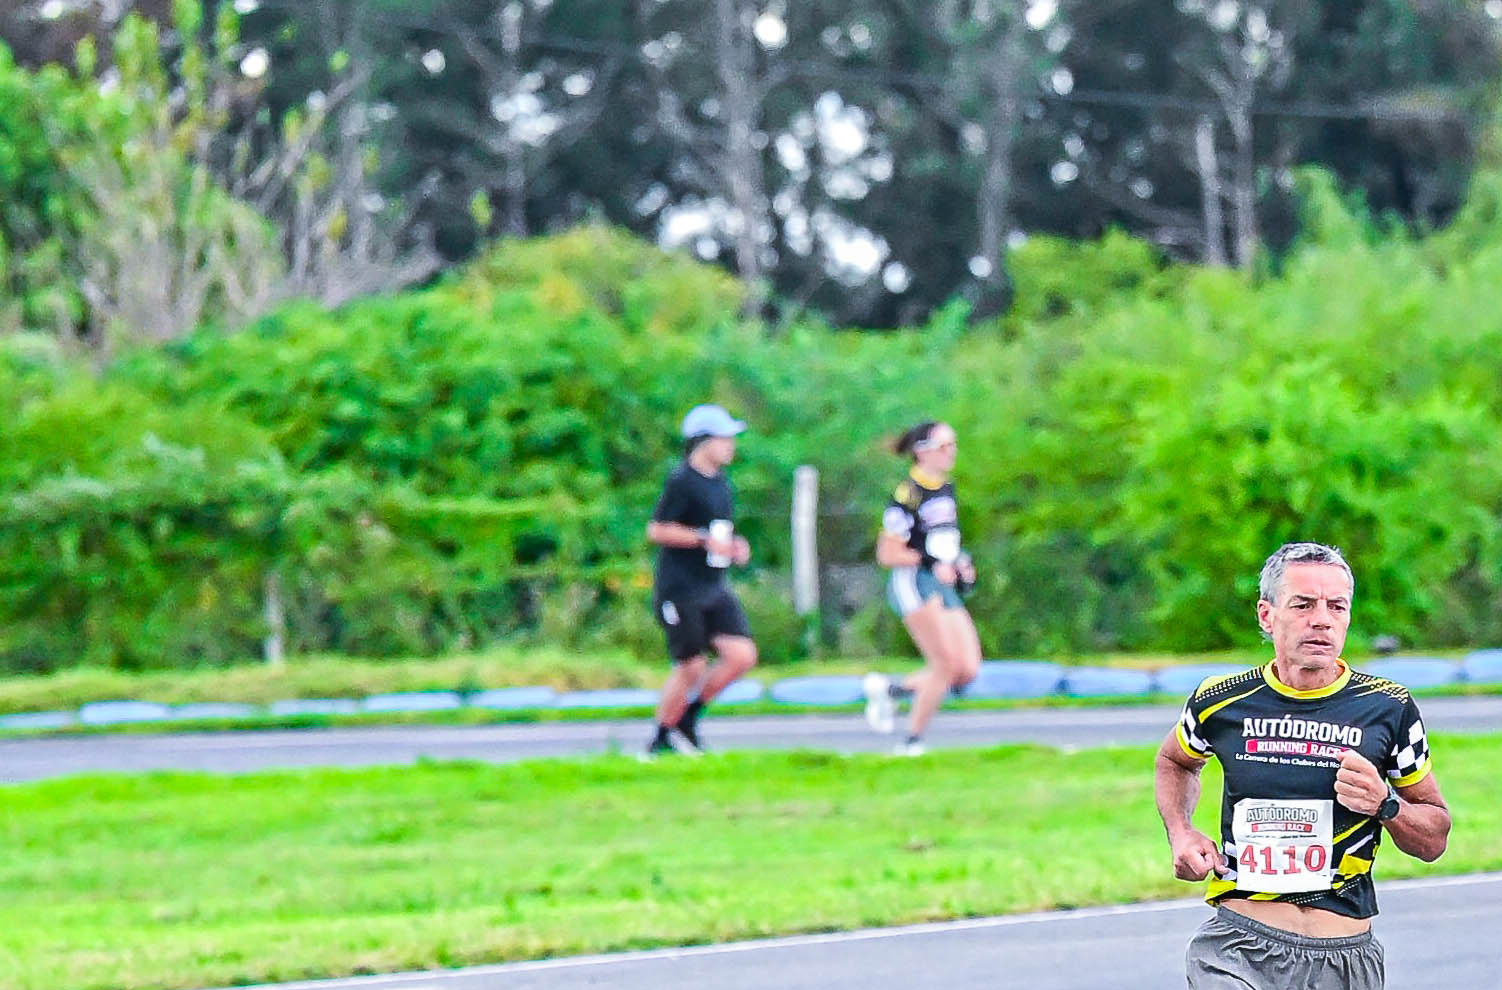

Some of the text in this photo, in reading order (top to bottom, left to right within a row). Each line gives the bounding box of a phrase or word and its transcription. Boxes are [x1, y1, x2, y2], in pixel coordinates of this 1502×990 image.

[1241, 714, 1363, 747] AUTÓDROMO
[1256, 740, 1308, 754] RUNNING
[1269, 755, 1279, 763] de
[1280, 757, 1291, 765] los
[1317, 760, 1329, 768] del
[1246, 803, 1319, 824] AUTÓDROMO
[1239, 844, 1327, 875] 4110
